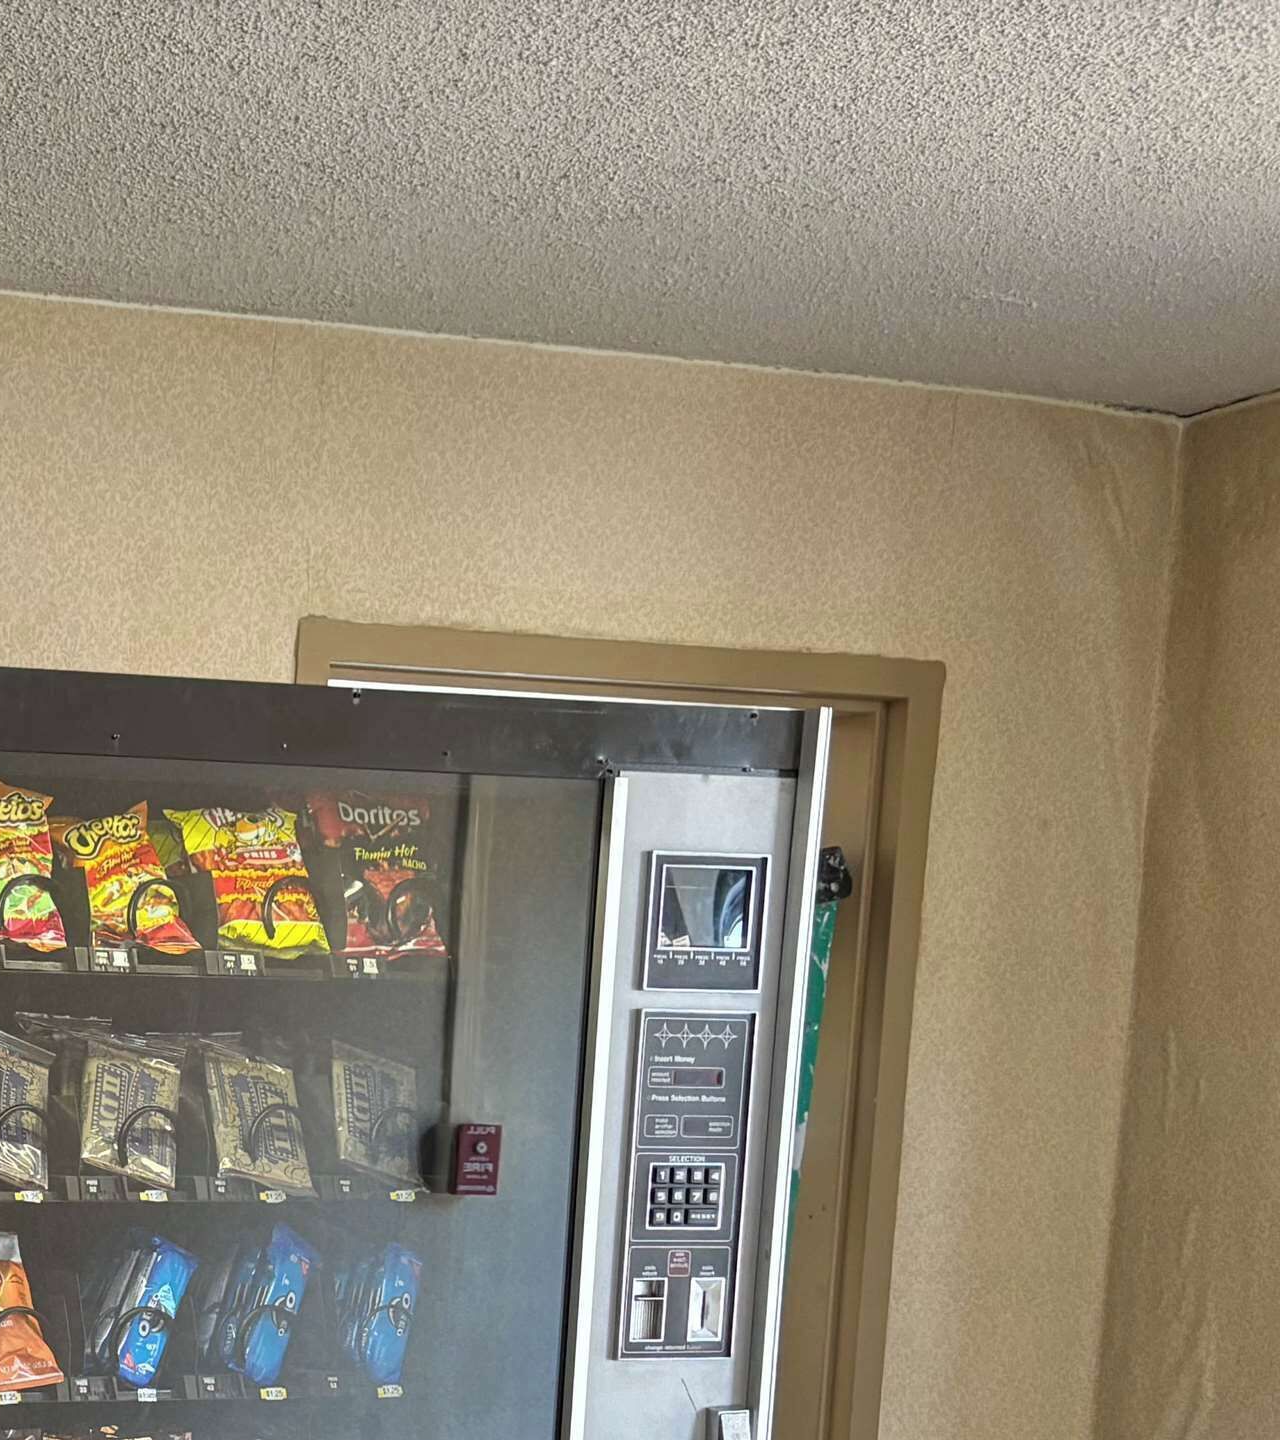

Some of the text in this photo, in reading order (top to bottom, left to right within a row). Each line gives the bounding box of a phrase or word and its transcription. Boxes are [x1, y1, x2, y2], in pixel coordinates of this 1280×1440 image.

[338, 801, 422, 827] Doritos
[402, 859, 428, 871] NACHO
[674, 1055, 695, 1064] Money
[671, 1094, 700, 1102] Selection
[669, 1155, 706, 1163] SELECTION
[660, 1171, 665, 1180] 1
[675, 1171, 685, 1180] 2
[711, 1172, 719, 1180] 4
[657, 1191, 718, 1201] 5 6 7 8
[655, 1212, 664, 1221] 9
[673, 1212, 681, 1221] 0
